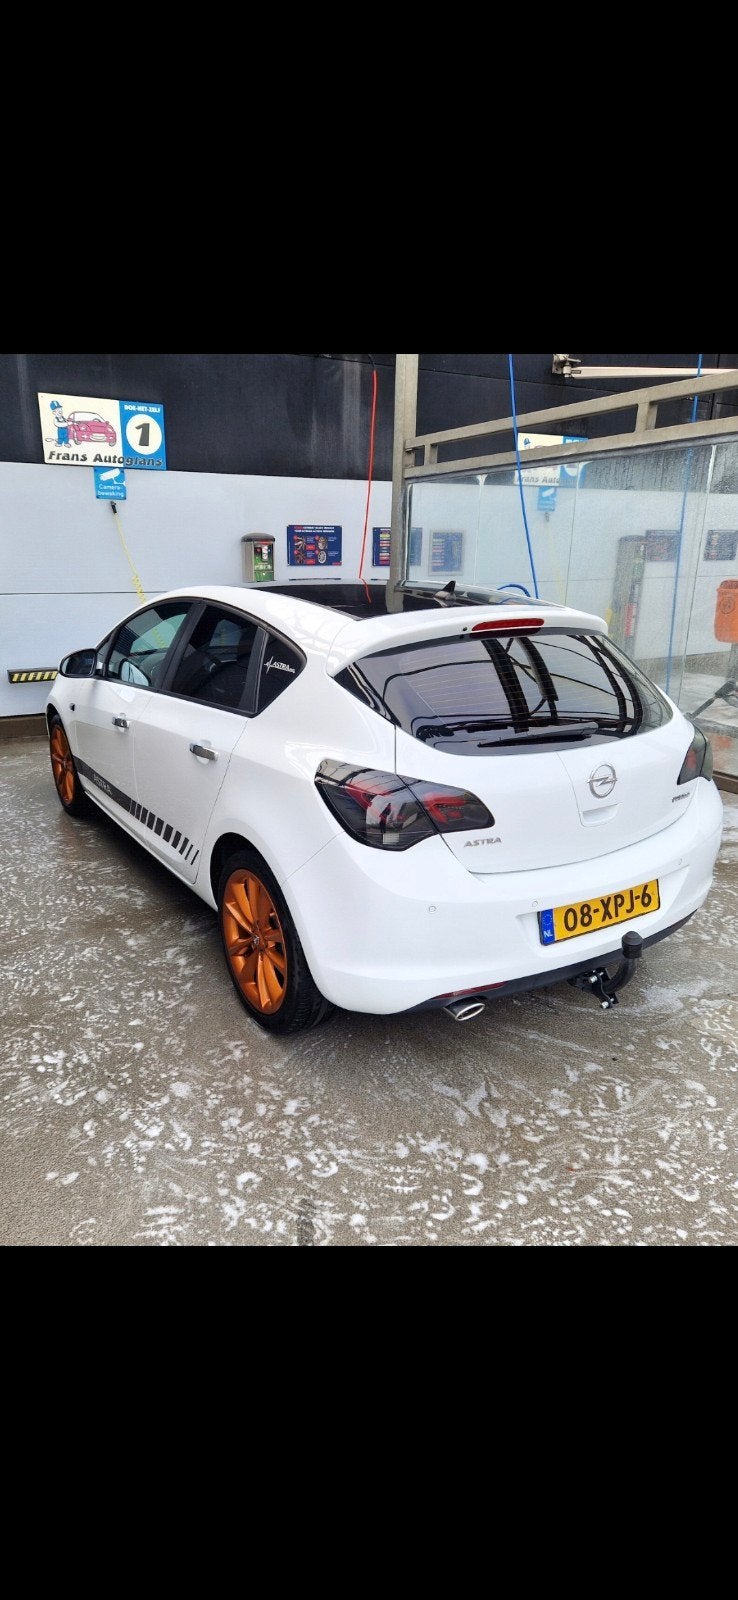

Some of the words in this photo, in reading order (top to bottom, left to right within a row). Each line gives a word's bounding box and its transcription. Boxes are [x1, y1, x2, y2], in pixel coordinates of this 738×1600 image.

[135, 422, 150, 447] 1
[48, 451, 88, 462] Frans
[93, 453, 162, 467] Autoglans
[97, 490, 125, 498] bewaking
[273, 661, 290, 671] ASTRA
[463, 837, 502, 848] ASTRA
[563, 884, 652, 933] 08-XPJ-6
[543, 929, 553, 939] NL
